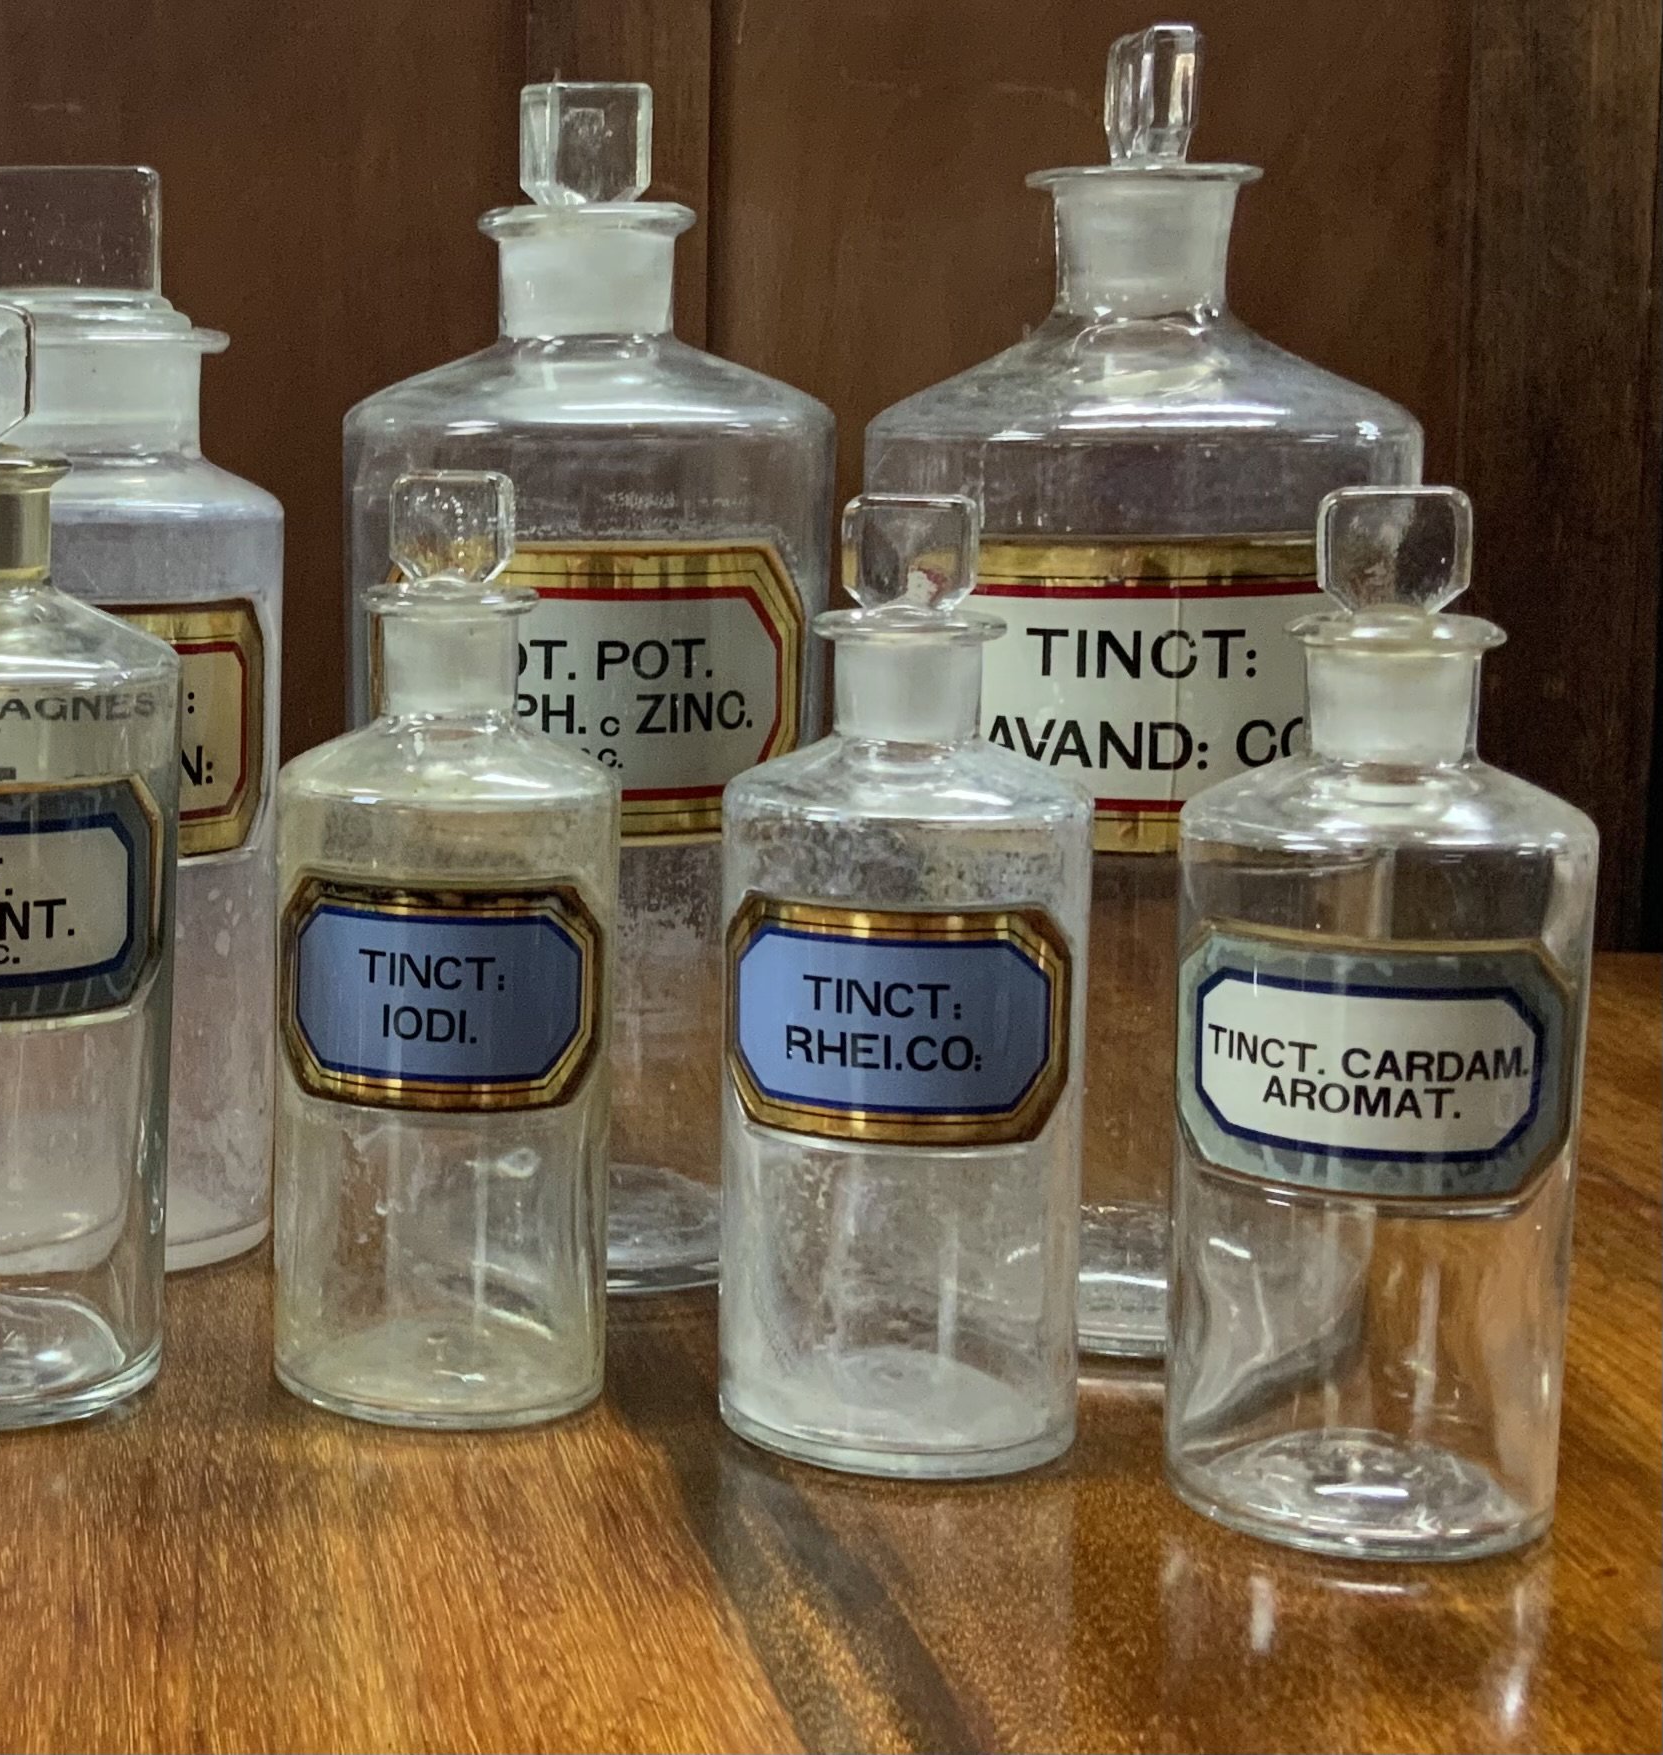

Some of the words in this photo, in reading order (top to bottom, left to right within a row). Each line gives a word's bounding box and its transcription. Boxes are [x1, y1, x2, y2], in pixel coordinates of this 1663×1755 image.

[596, 638, 713, 680] POT.
[1026, 627, 1257, 679] TINCT:
[516, 693, 587, 734] PH.
[635, 689, 753, 734] ZINC.
[988, 714, 1209, 770] AVAND:
[358, 948, 505, 991] TINCT:
[802, 974, 962, 1020] TINCT:
[382, 1003, 478, 1044] IODI.
[1208, 1023, 1326, 1075] TINCT.
[1341, 1046, 1531, 1083] CARDAM.
[1262, 1075, 1462, 1120] AROMAT.
